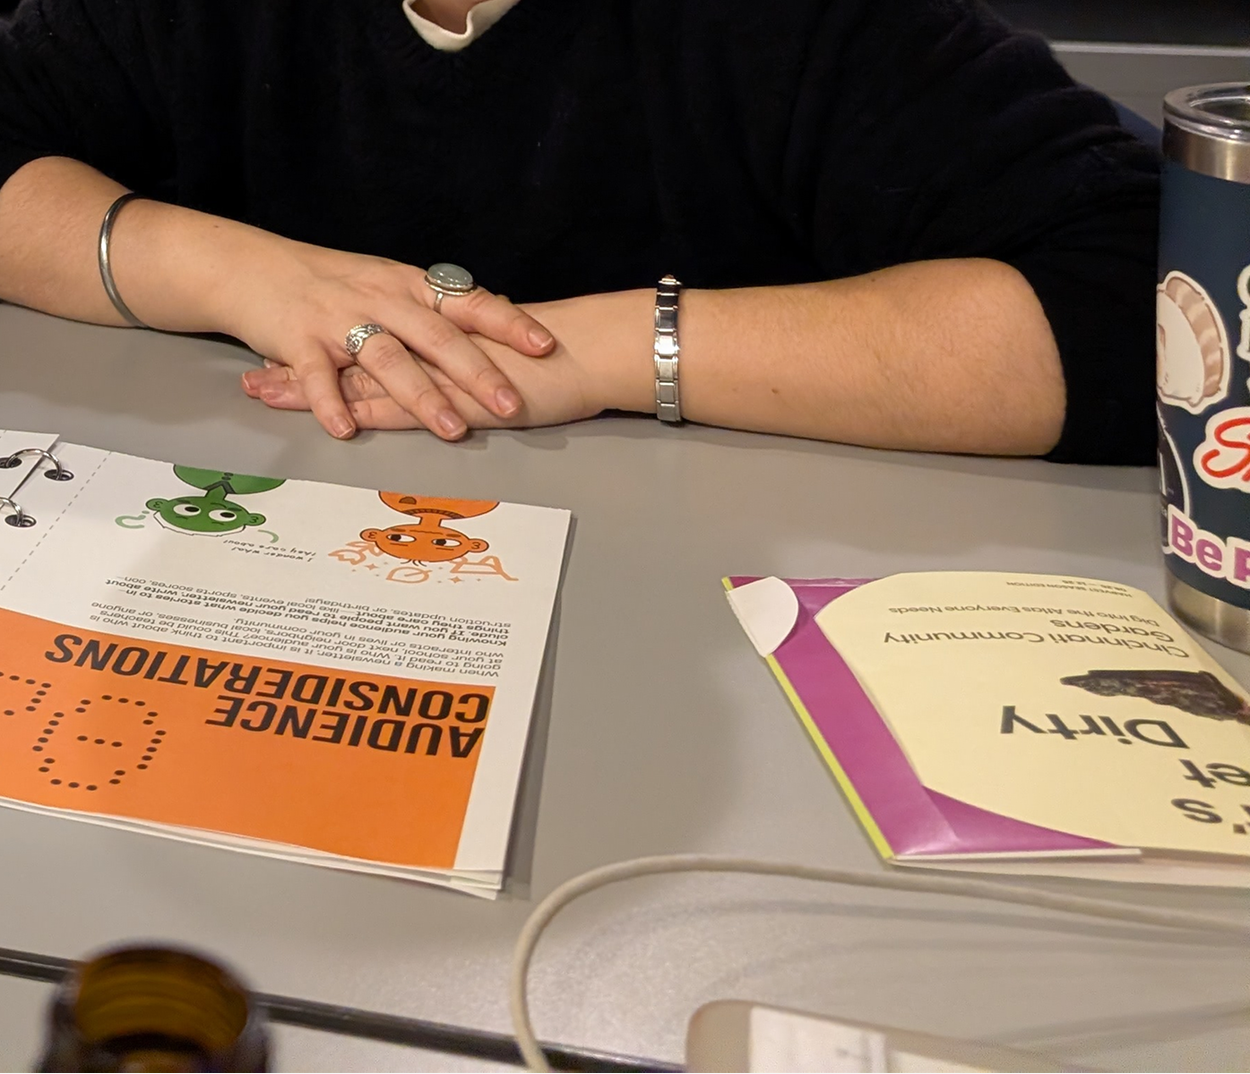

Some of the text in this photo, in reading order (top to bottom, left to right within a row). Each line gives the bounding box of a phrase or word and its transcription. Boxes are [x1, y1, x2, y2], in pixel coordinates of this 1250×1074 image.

[1171, 514, 1223, 572] Be
[149, 580, 194, 592] scores,
[139, 591, 153, 599] to
[195, 588, 238, 599] sports
[155, 594, 202, 606] stories
[240, 594, 285, 607] events,
[304, 598, 370, 612] birthdays!
[91, 602, 137, 614] anyone
[105, 579, 509, 640] clude. If you want people to read your newsletter, write about
[203, 601, 237, 611] what
[286, 601, 316, 611] local
[99, 610, 156, 625] teachers
[238, 607, 283, 617] decide
[284, 613, 309, 621] you
[390, 608, 447, 622] updates,
[888, 604, 1161, 628] Dig Into the Atlas Everyone Needs
[89, 614, 101, 622] is
[102, 617, 129, 627] who
[156, 613, 229, 630] businesses,
[311, 617, 347, 628] helps
[397, 616, 429, 625] care
[449, 617, 512, 628] struction
[131, 622, 169, 633] about
[158, 620, 175, 628] be
[176, 623, 212, 633] could
[230, 624, 261, 634] local
[233, 618, 308, 634] community.
[349, 622, 406, 635] audience
[431, 620, 463, 630] they
[170, 628, 202, 639] think
[214, 629, 240, 638] This
[309, 630, 341, 639] your
[412, 631, 446, 640] your
[466, 625, 510, 635] things
[1051, 619, 1175, 645] Gardens
[205, 634, 219, 642] to
[242, 633, 310, 647] audience?
[264, 628, 332, 644] neighbors,
[358, 636, 388, 646] lives
[448, 634, 507, 647] Knowing
[221, 636, 287, 652] important
[311, 643, 343, 652] your
[333, 640, 367, 649] door
[368, 644, 399, 653] next
[409, 643, 472, 656] interacts
[883, 630, 1190, 660] Cincinnati Community
[316, 650, 391, 666] newsletter,
[360, 649, 391, 660] Who
[394, 654, 407, 662] it.
[401, 648, 449, 660] school,
[451, 652, 485, 662] your
[474, 650, 504, 658] who
[407, 656, 443, 665] read
[462, 661, 501, 670] going
[405, 661, 456, 673] making
[45, 634, 490, 722] CONSIDERATIONS
[458, 668, 499, 678] When
[205, 695, 484, 760] AUDIENCE
[998, 705, 1191, 750] Dirty
